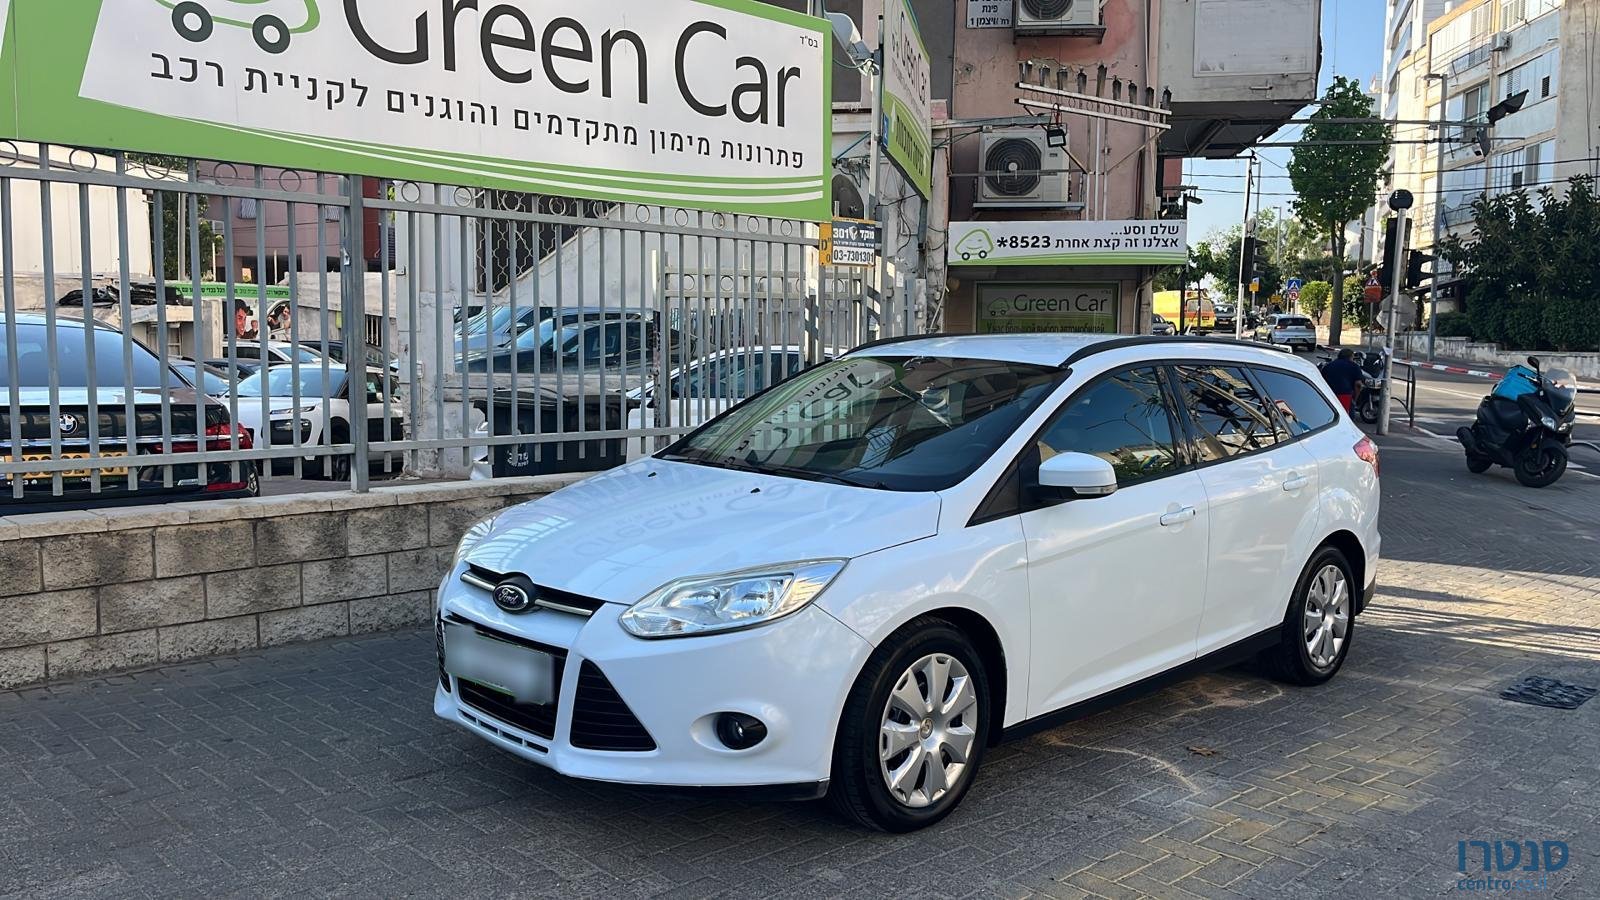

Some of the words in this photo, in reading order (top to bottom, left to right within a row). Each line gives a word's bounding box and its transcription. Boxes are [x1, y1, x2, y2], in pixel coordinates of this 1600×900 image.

[150, 52, 225, 88] רכב
[343, 0, 648, 105] Green
[674, 20, 801, 128] Car
[243, 66, 369, 111] לקניית
[386, 89, 499, 127] והוגנים
[513, 107, 639, 146] מתקדמים
[649, 128, 711, 156] מימון
[720, 139, 804, 170] פתרונות
[832, 227, 849, 239] 301
[1151, 224, 1179, 236] שלם
[1055, 237, 1090, 249] אחרת
[1093, 237, 1121, 251] קצת
[1124, 237, 1138, 248] זה
[1143, 235, 1179, 248] אצלנו
[833, 249, 874, 263] 03-7301301
[1013, 293, 1070, 312] Green
[1074, 293, 1108, 312] Car
[498, 586, 519, 605] Ford
